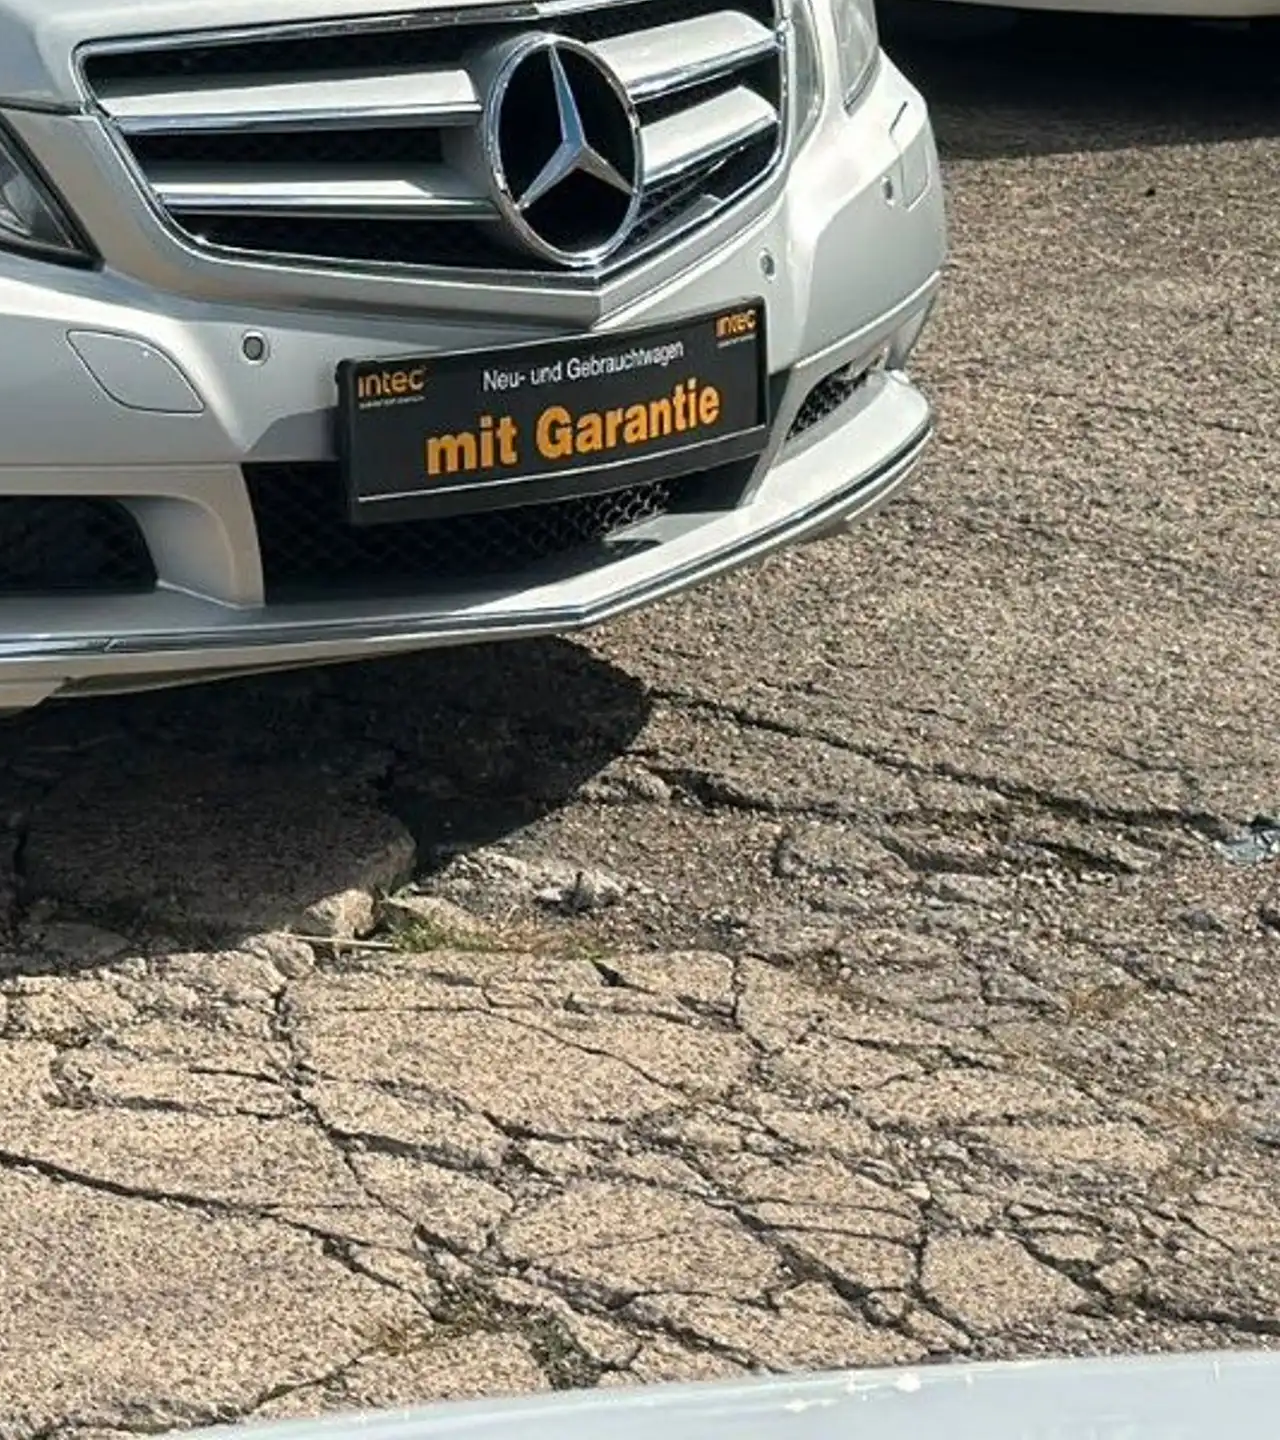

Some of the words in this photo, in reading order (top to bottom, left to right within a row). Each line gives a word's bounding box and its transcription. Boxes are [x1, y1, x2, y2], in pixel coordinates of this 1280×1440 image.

[357, 368, 426, 399] intec
[482, 368, 526, 392] Neu-
[530, 360, 562, 386] und
[566, 340, 685, 381] Gebrauchtwagen
[426, 415, 518, 475] mit
[535, 377, 720, 460] Garantie
